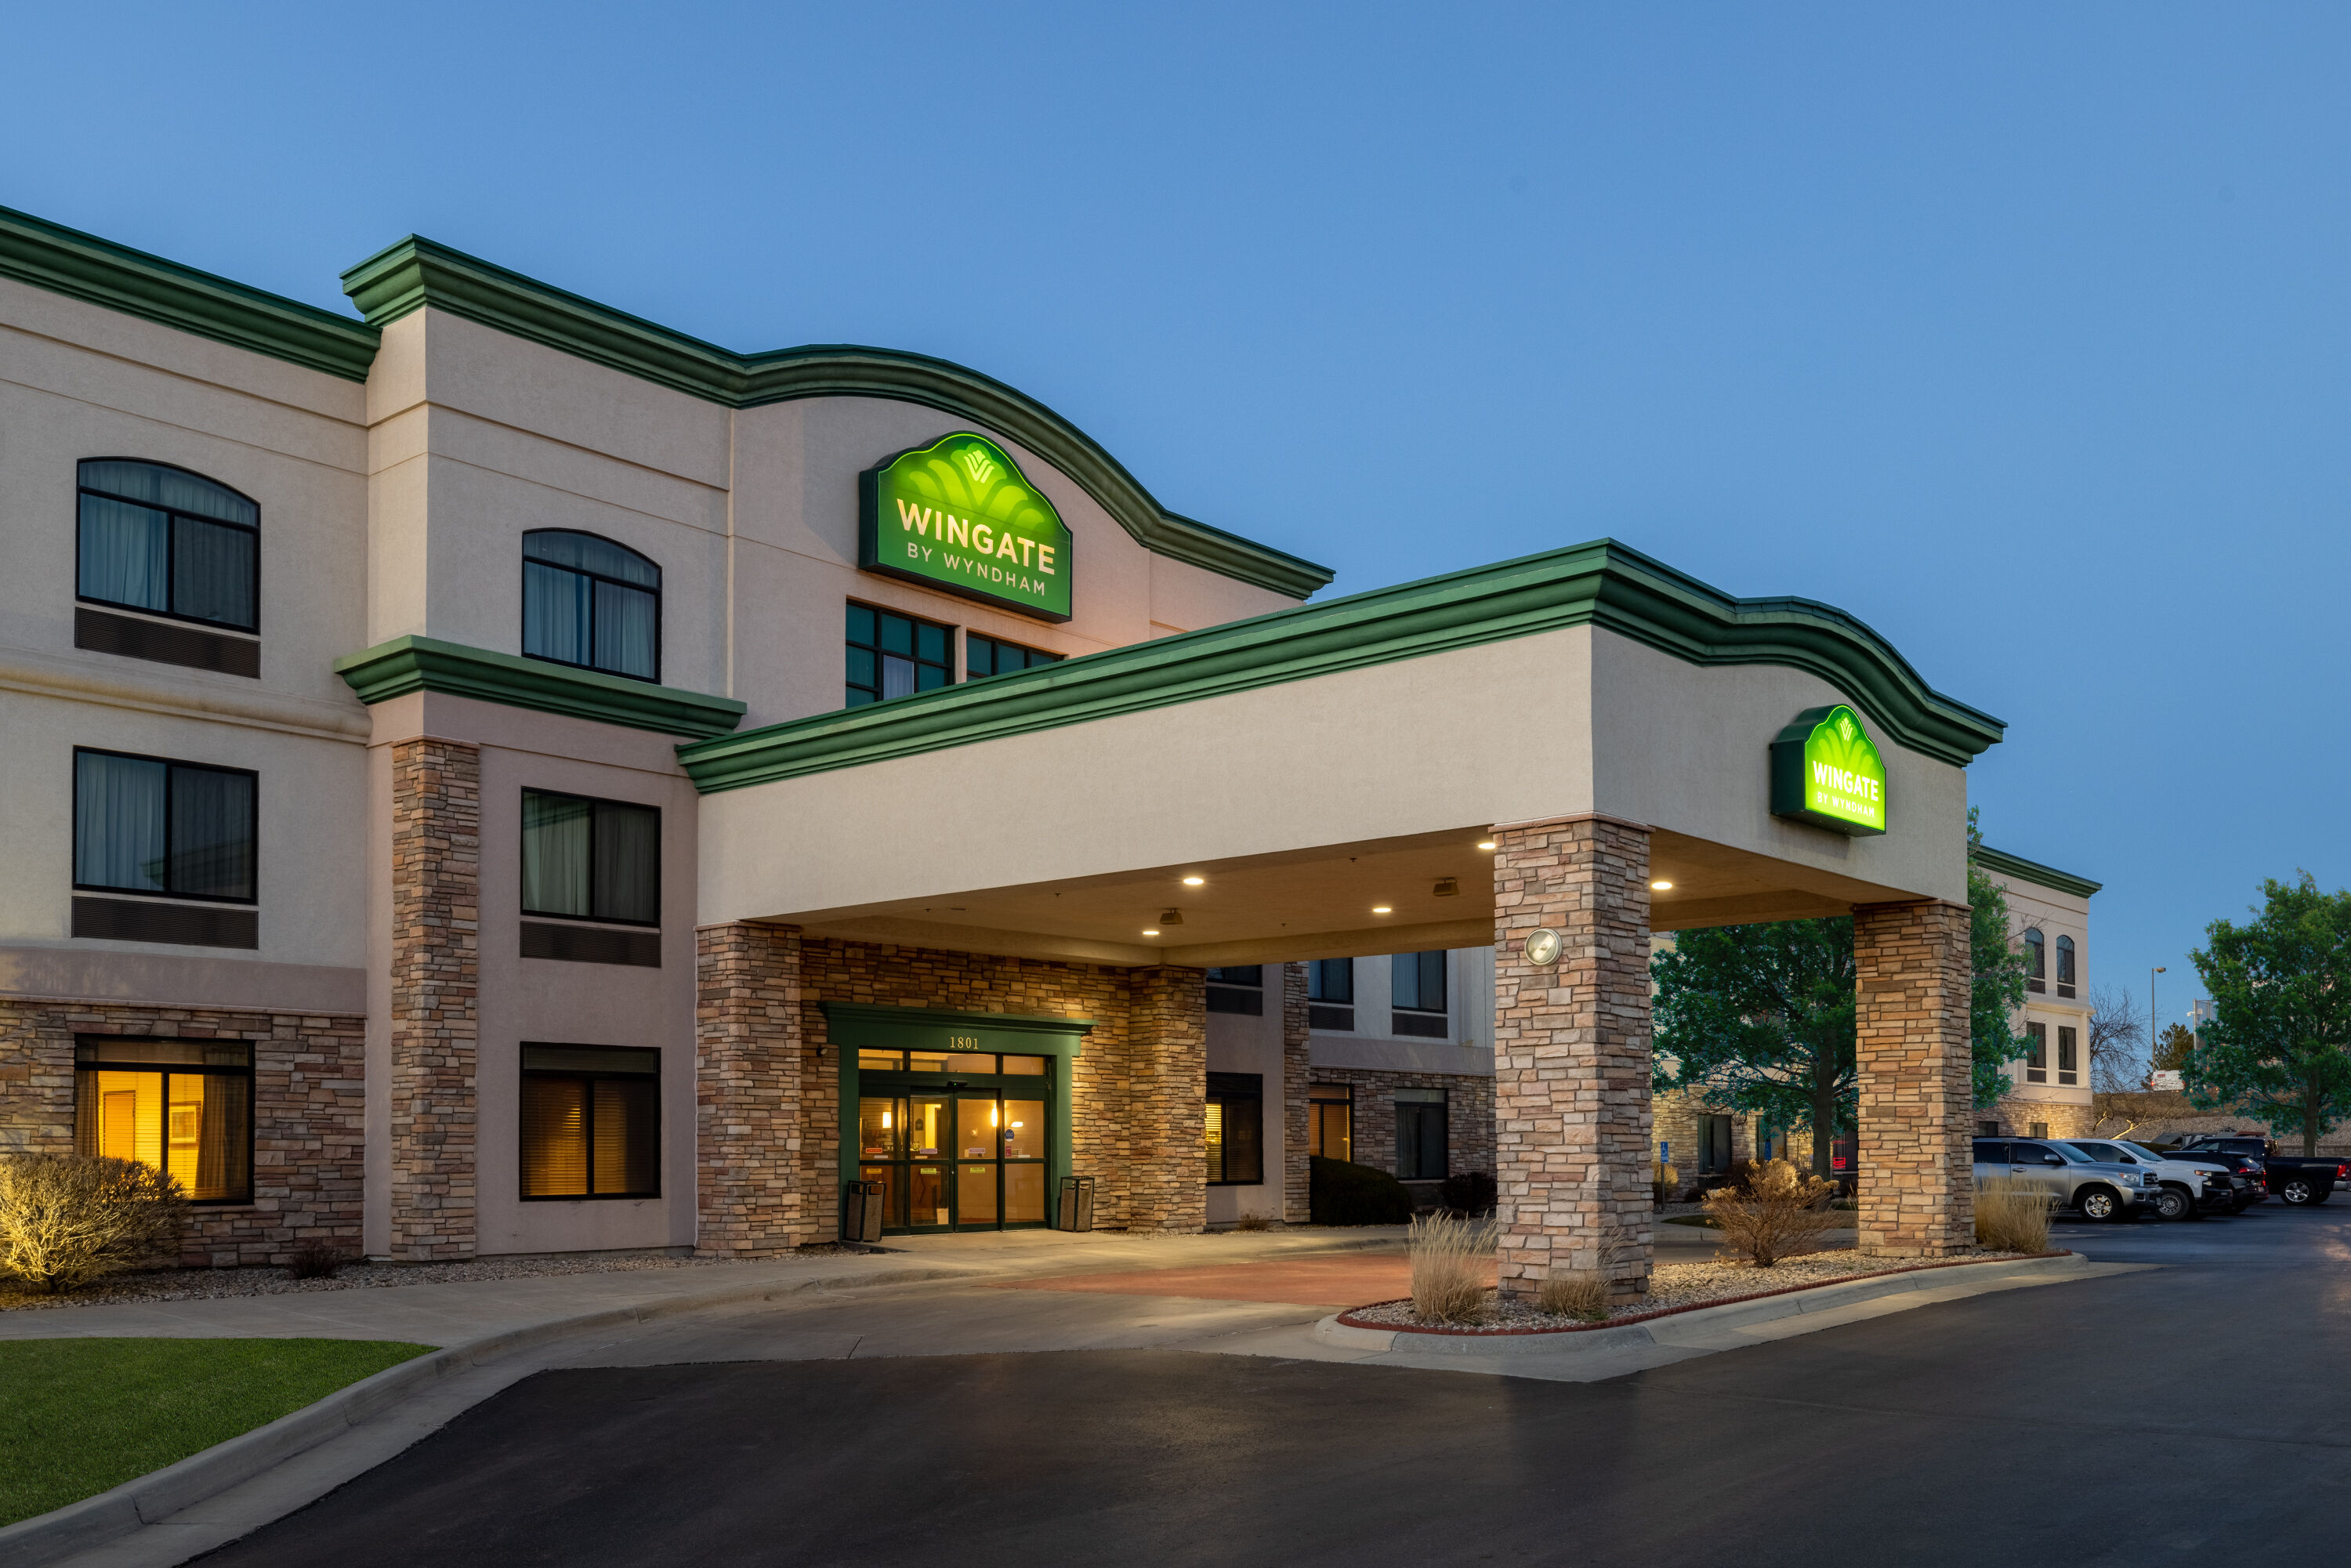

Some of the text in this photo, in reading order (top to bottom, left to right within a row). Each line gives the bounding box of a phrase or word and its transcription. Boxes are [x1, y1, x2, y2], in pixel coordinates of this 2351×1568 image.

[897, 498, 1055, 575] WINGATE
[907, 542, 1045, 596] BY WYNDHAM
[1813, 761, 1878, 802] WINGATE
[1817, 791, 1875, 817] BY WYNDHAM
[950, 1037, 978, 1049] 1801
